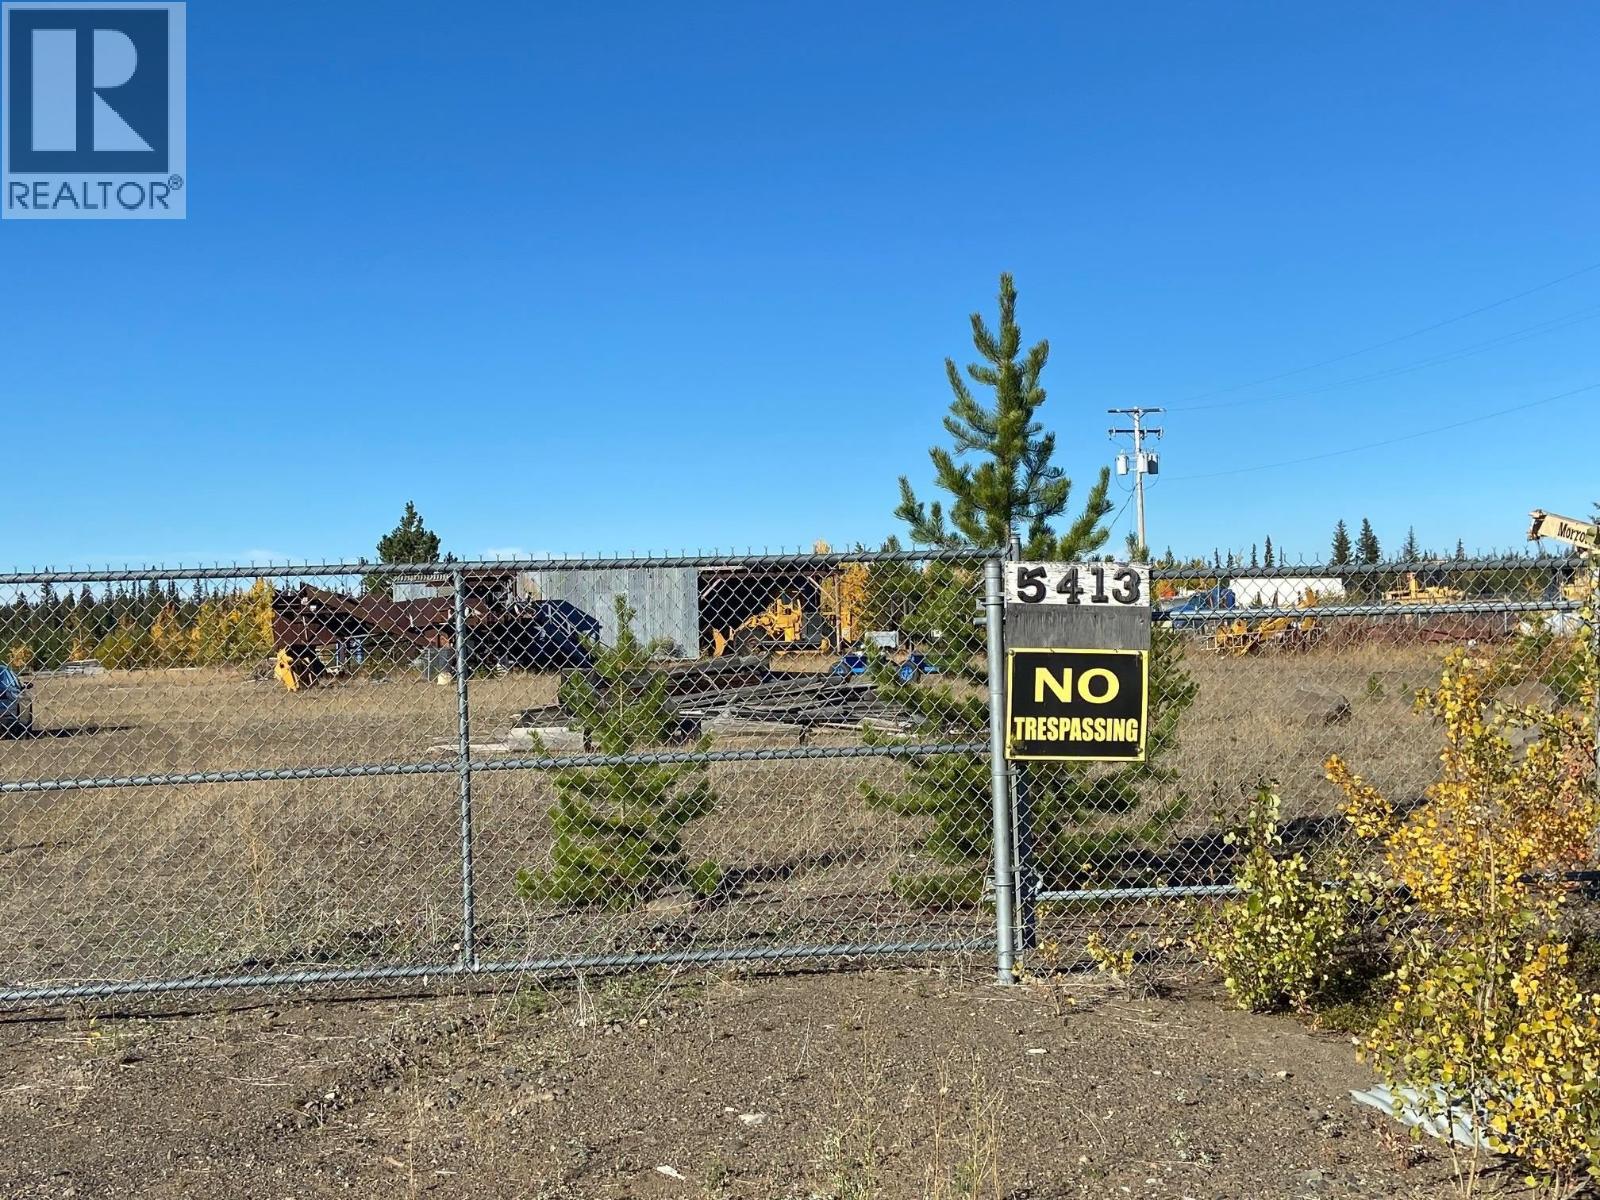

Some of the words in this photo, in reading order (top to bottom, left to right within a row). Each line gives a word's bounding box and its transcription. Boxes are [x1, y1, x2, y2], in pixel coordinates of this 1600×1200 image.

[1558, 522, 1588, 544] Morro
[1017, 566, 1141, 604] 5413
[1034, 667, 1120, 704] NO
[1014, 716, 1139, 742] TRESPASSING
